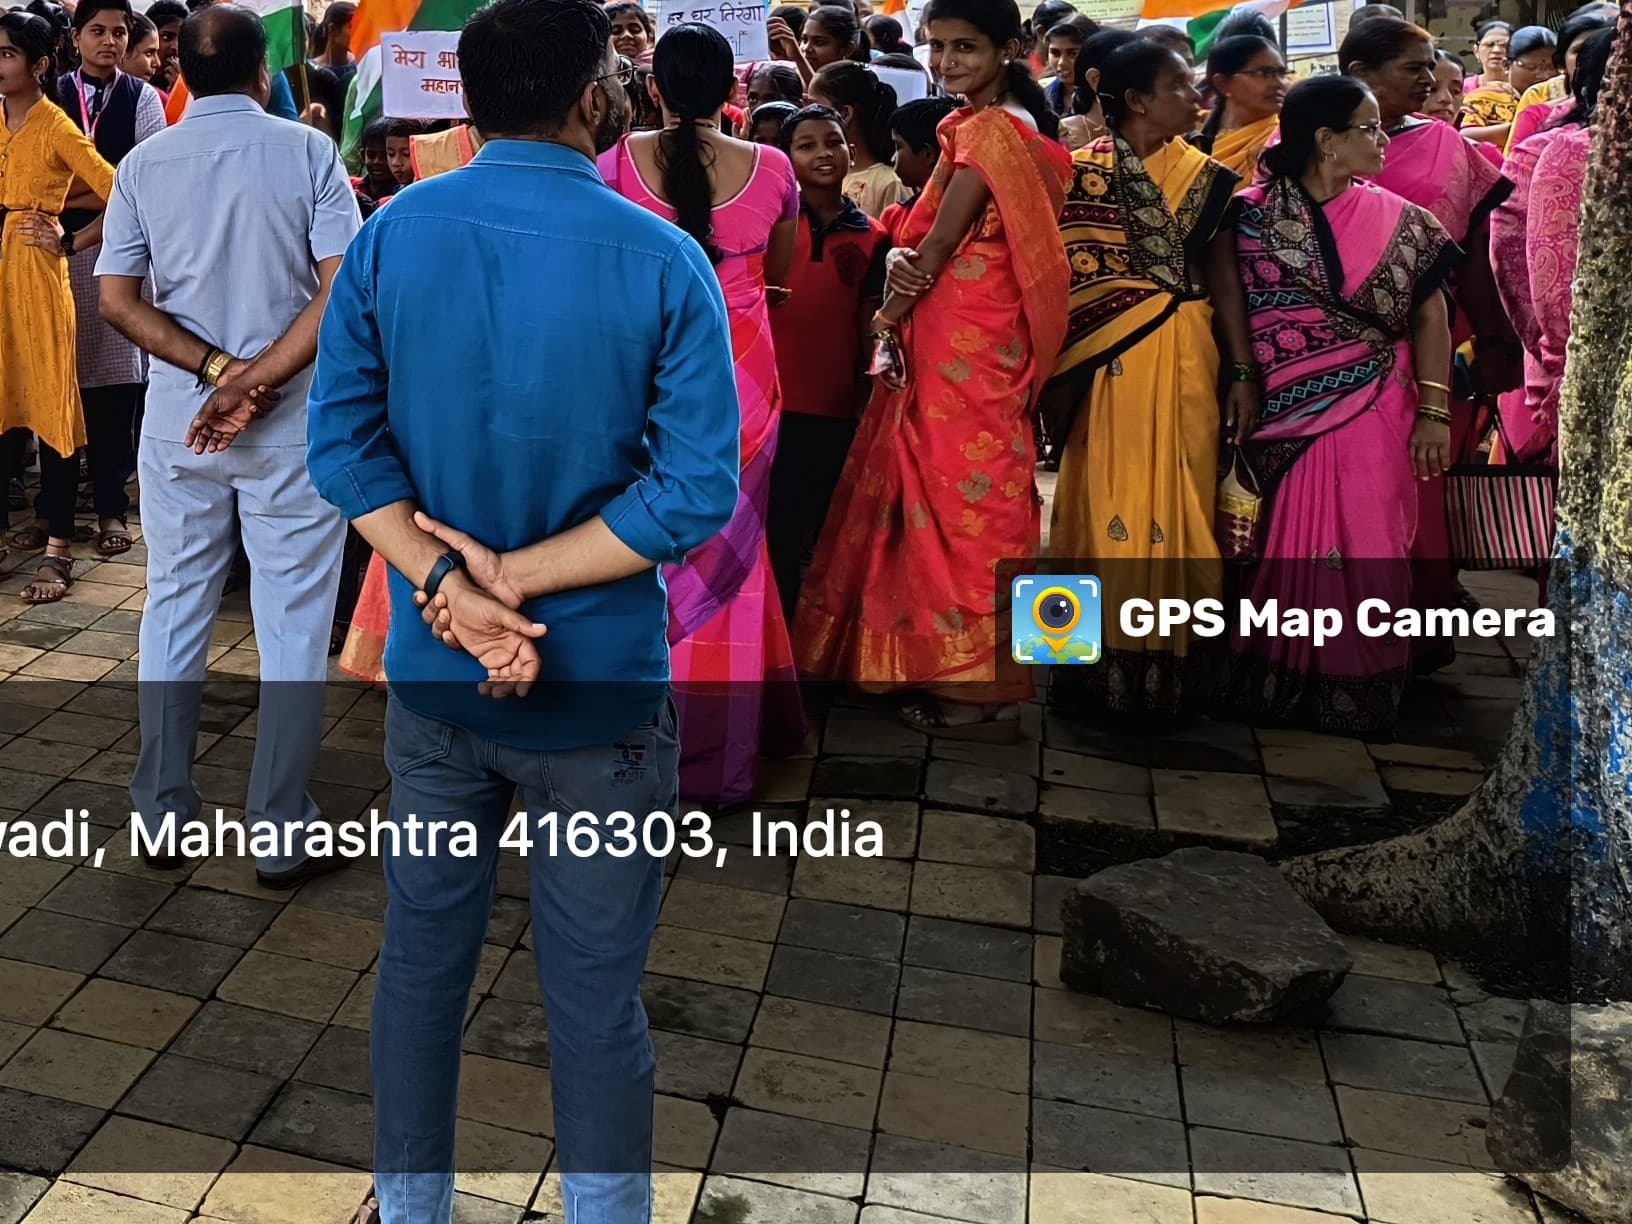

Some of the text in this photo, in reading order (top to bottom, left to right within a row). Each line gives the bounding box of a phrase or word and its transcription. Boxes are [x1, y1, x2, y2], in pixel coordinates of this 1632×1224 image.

[691, 8, 718, 25] घर
[719, 1, 765, 26] तिरंगा
[390, 44, 458, 70] मेरा भा
